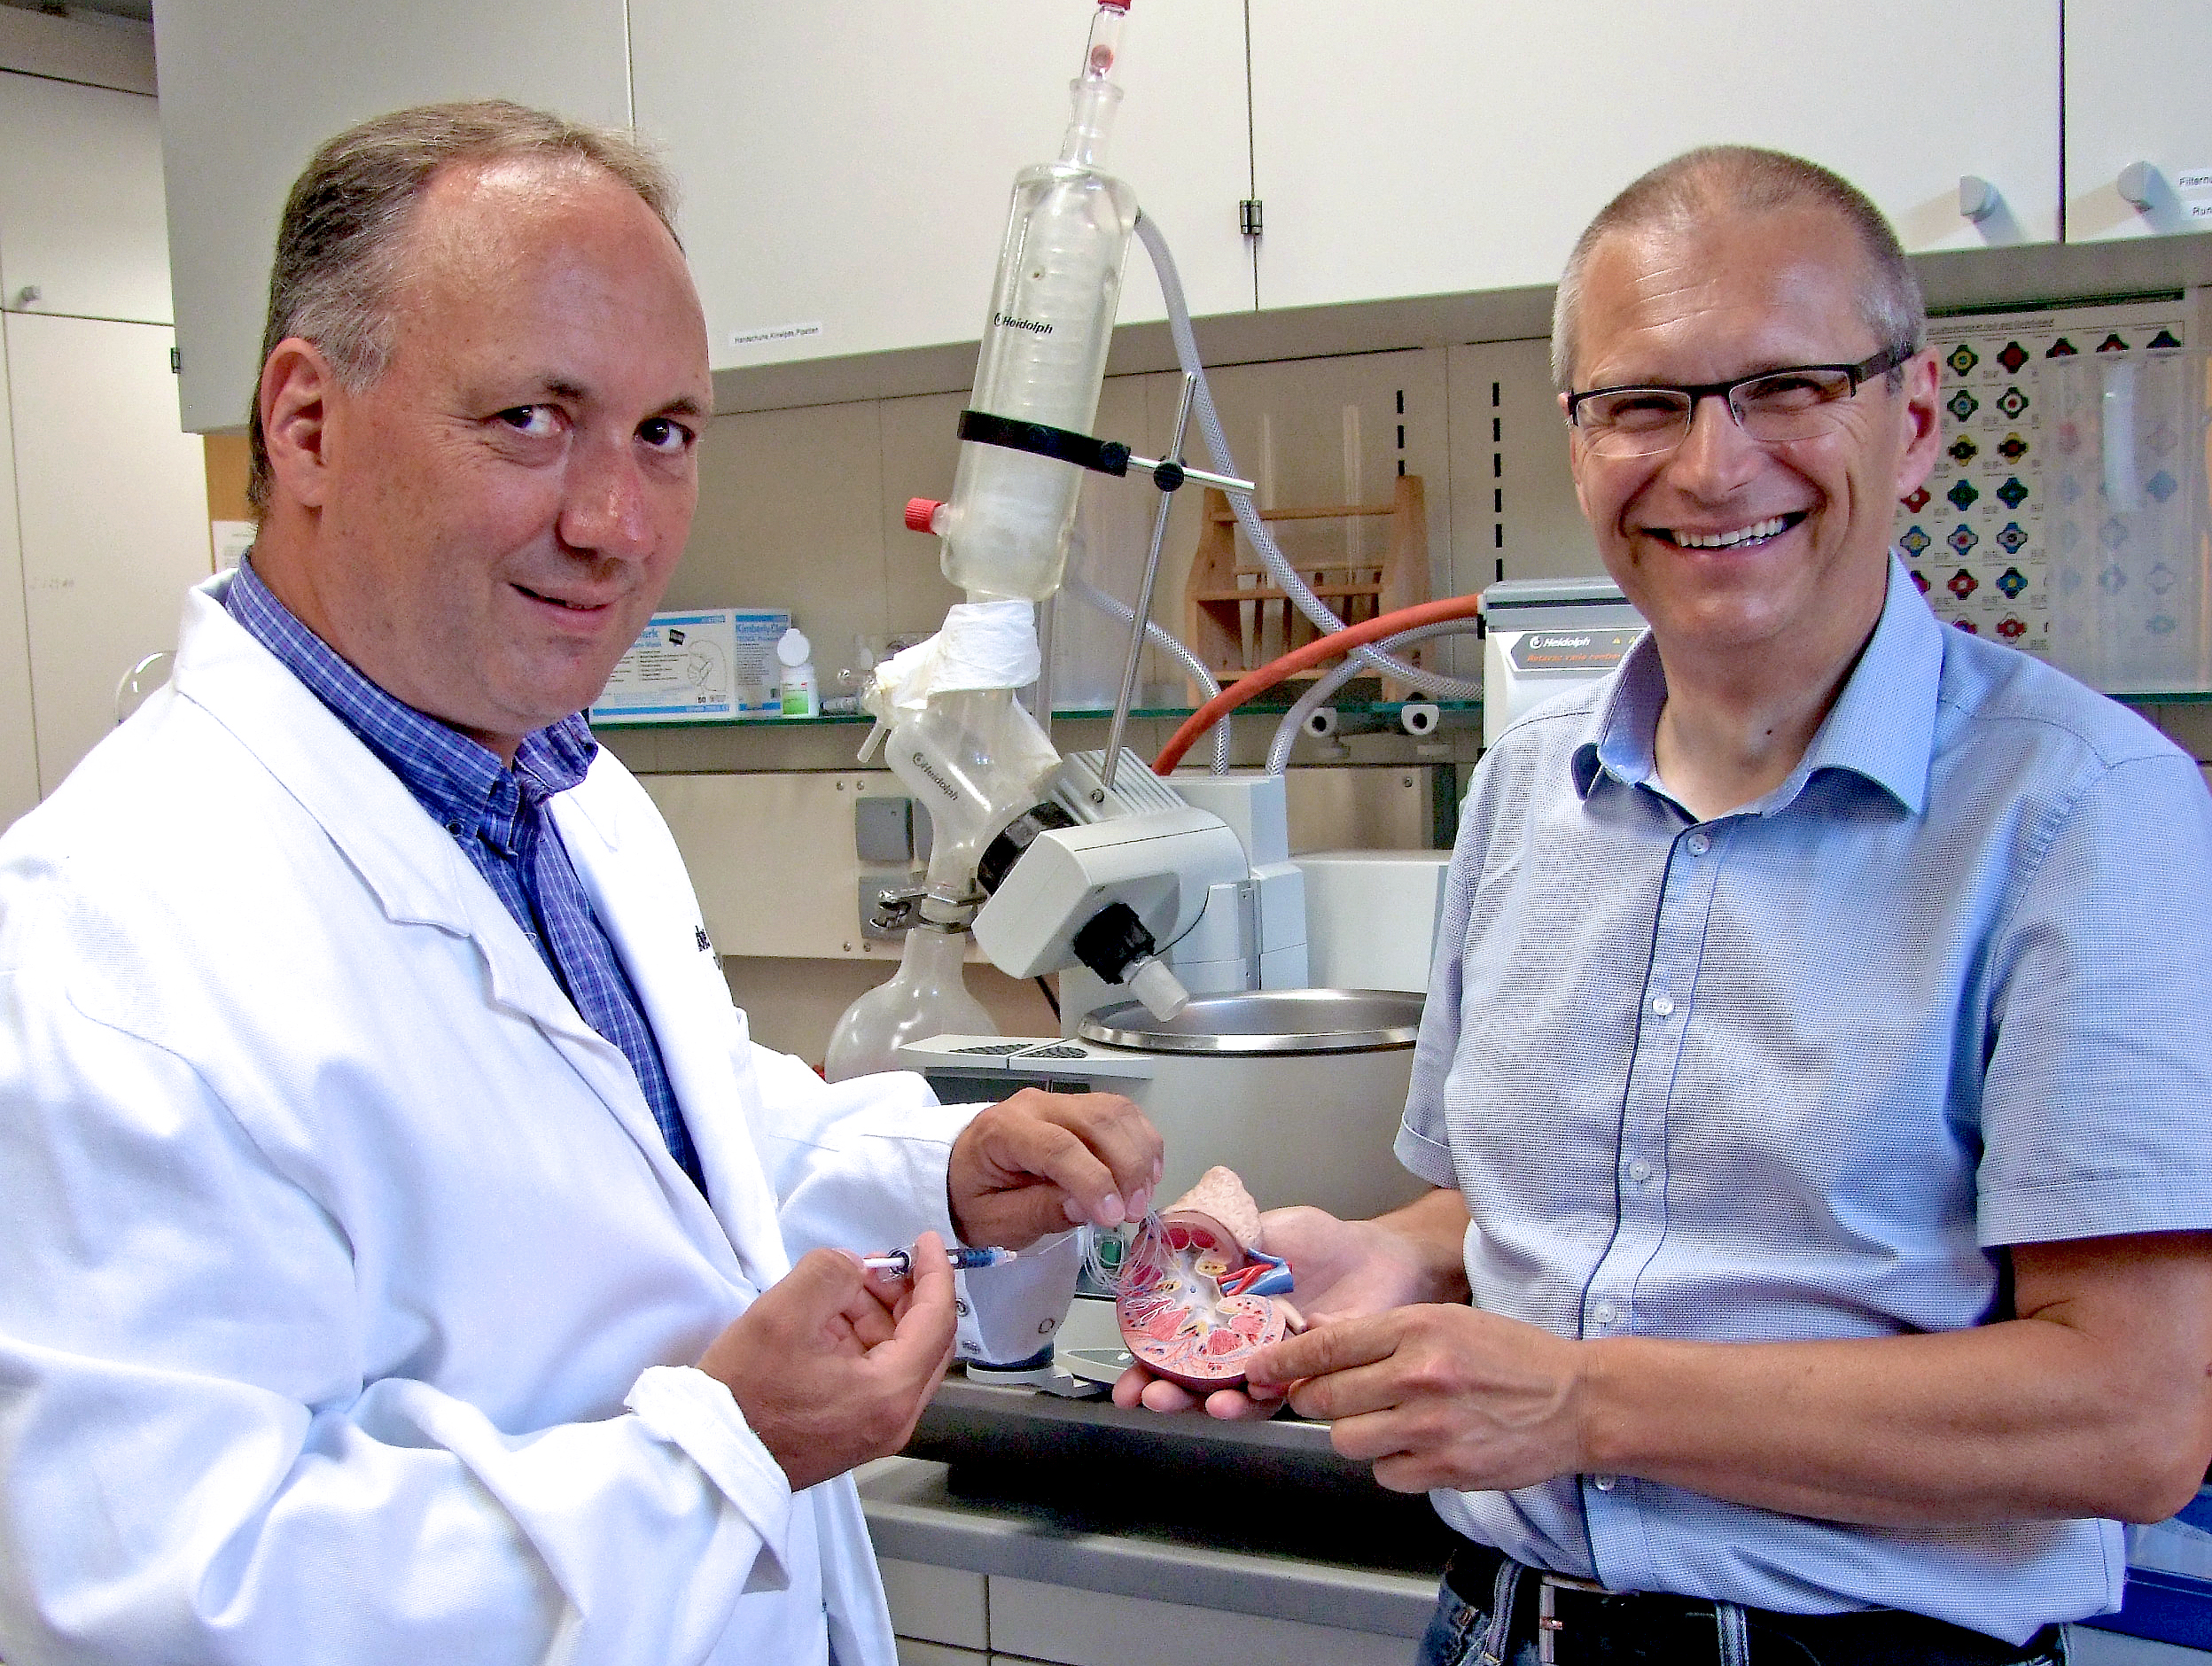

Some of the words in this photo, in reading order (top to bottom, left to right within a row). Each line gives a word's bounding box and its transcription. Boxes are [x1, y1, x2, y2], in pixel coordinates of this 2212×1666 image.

[1004, 317, 1053, 333] Heidolph
[1544, 636, 1591, 648] Heidolph
[921, 763, 958, 800] Heidolph
